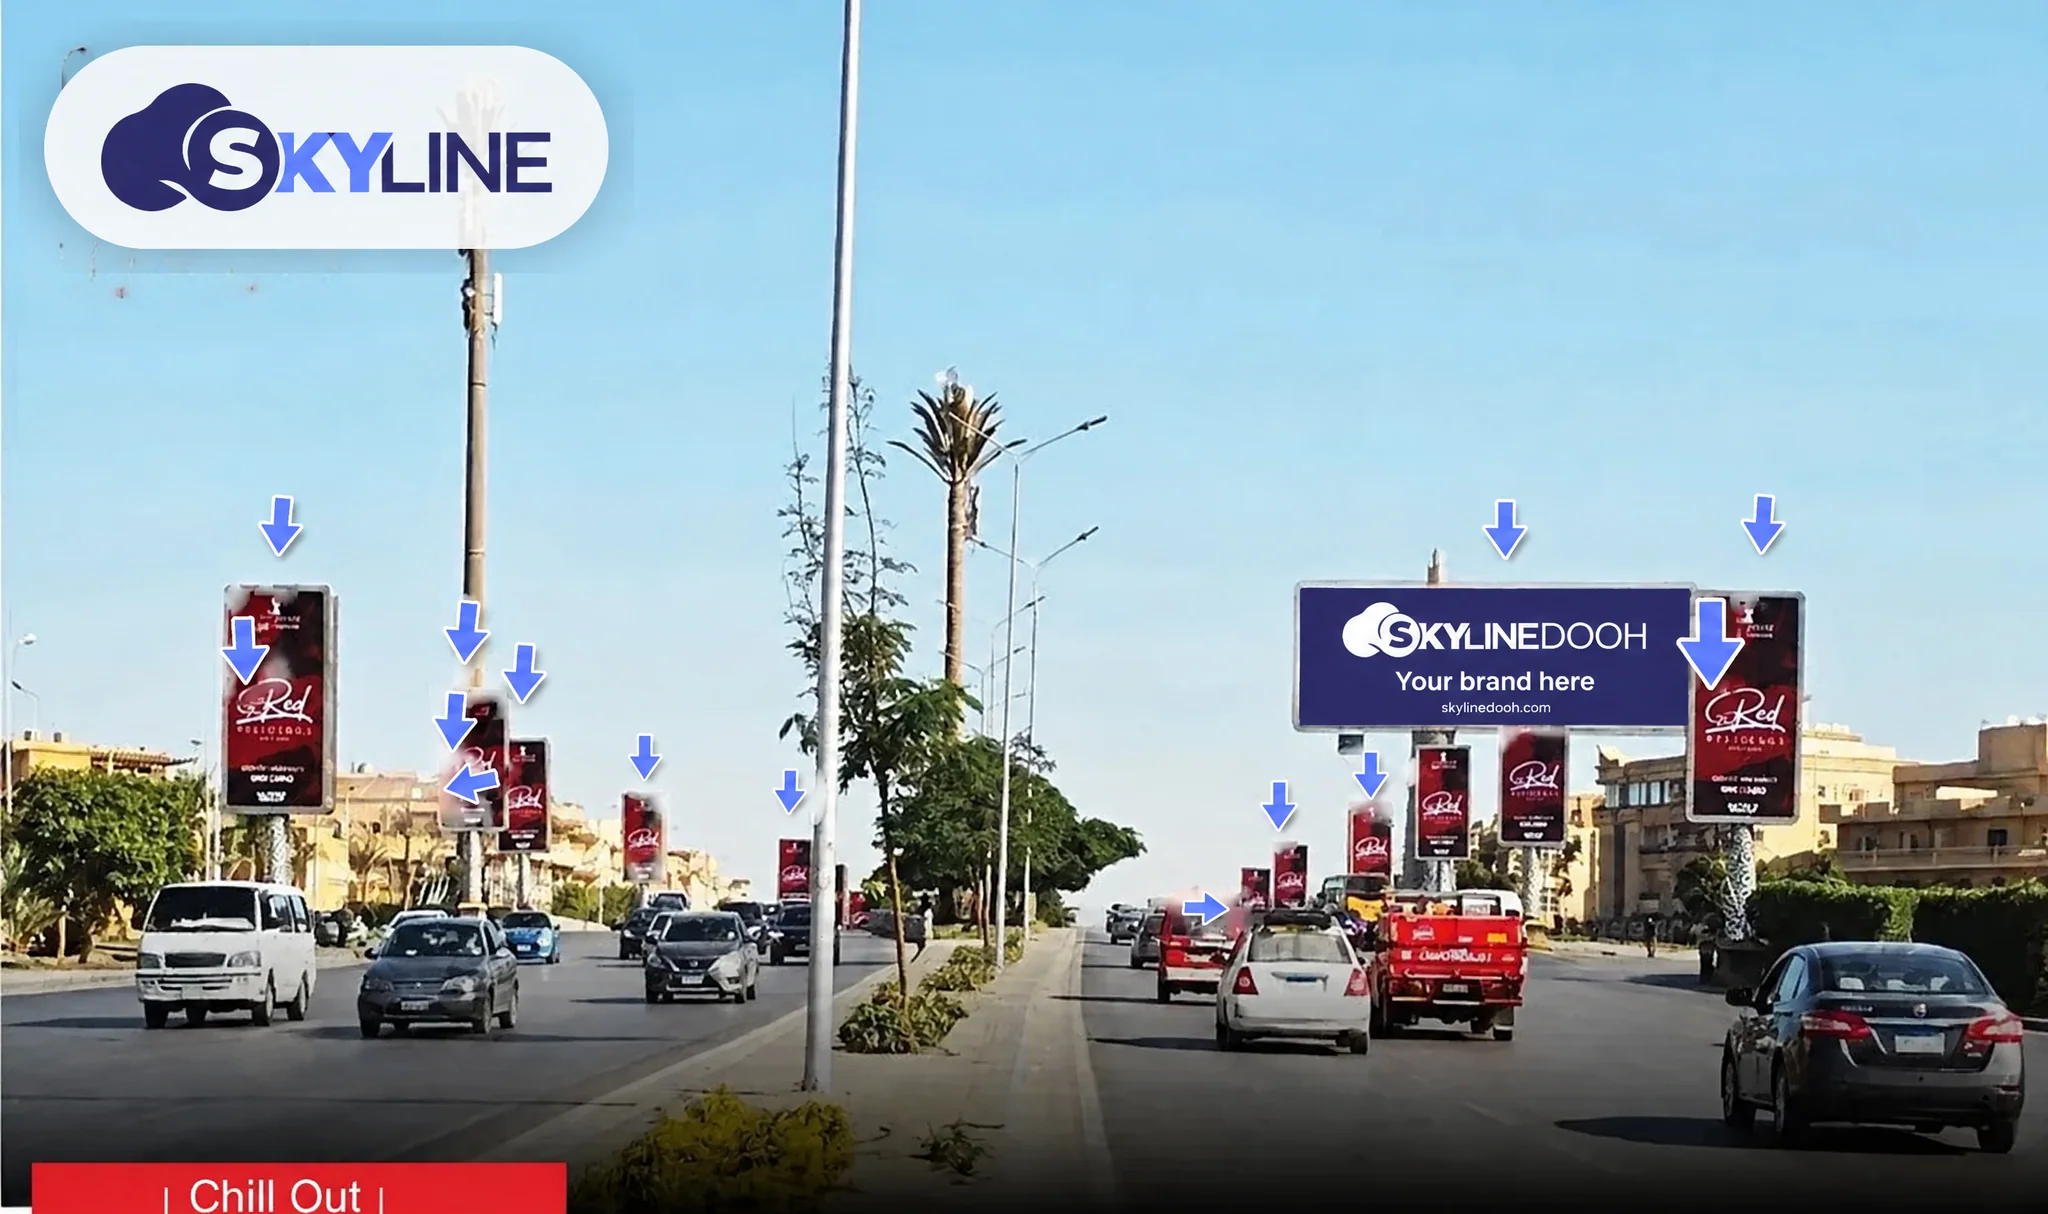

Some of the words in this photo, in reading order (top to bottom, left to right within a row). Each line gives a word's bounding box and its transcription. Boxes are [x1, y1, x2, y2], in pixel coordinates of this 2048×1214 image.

[1388, 621, 1647, 650] SKYLINEDOOH
[1396, 671, 1453, 691] Your
[1460, 670, 1531, 691] brand
[1539, 670, 1595, 691] here
[1441, 701, 1551, 716] skylinedooh.com
[1705, 687, 1787, 734] Red
